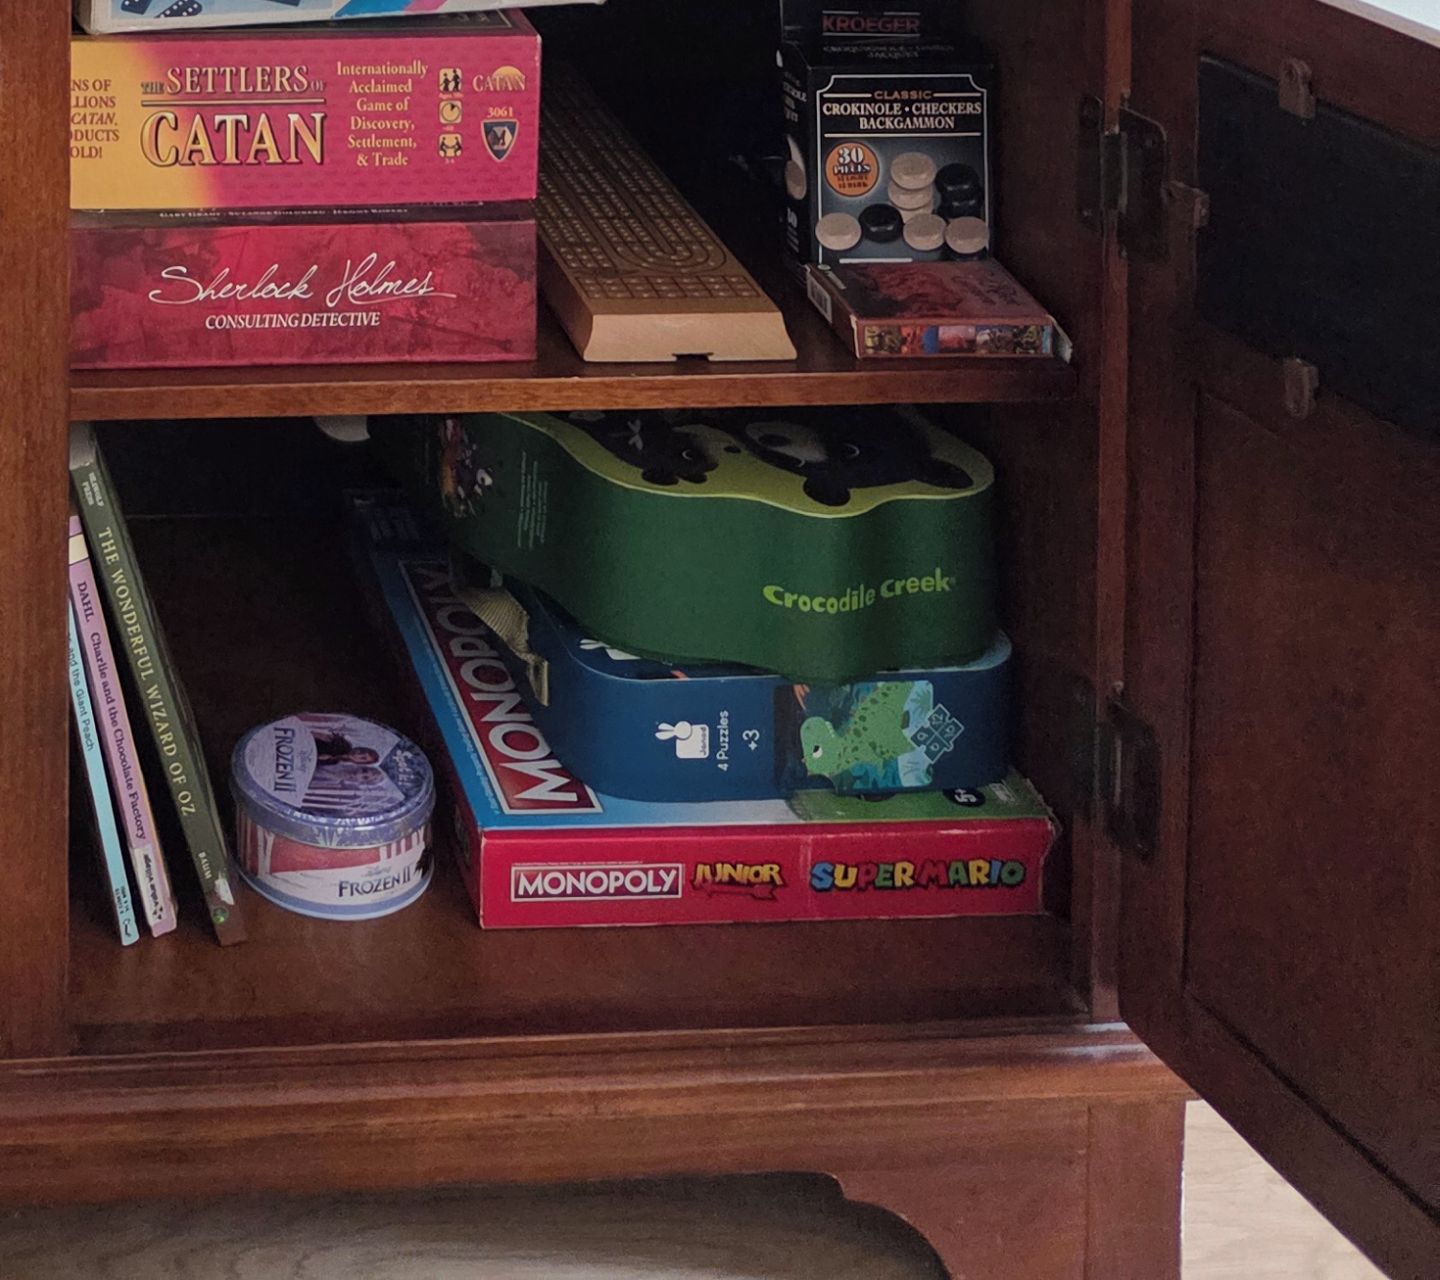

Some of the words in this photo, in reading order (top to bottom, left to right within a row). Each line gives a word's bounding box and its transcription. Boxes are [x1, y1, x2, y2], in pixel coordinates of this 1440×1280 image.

[821, 16, 921, 33] KROEGER
[166, 64, 309, 95] SETTLERS
[310, 80, 326, 93] OF
[337, 59, 429, 79] Internationally
[349, 79, 412, 94] Acclaimed
[472, 73, 526, 93] CATAN
[356, 98, 393, 112] Game
[396, 96, 410, 111] of
[874, 90, 933, 100] CLASSIC
[486, 106, 514, 119] 3061
[822, 102, 902, 116] CROKINOLE
[911, 101, 982, 116] CHECKERS
[350, 116, 415, 133] Discovery,
[859, 116, 955, 130] BACKGAMMON
[140, 110, 327, 167] CATAN
[347, 135, 417, 149] Settlement,
[356, 154, 368, 167] &
[372, 152, 409, 167] Trade
[838, 146, 864, 164] 30
[149, 263, 319, 305] Sherlock
[325, 252, 457, 307] Holmes
[205, 312, 300, 330] CONSULTING
[300, 311, 381, 328] DETECTIVE
[77, 580, 95, 623] DAHL
[762, 583, 876, 614] Crocodile
[879, 566, 951, 598] Creek
[90, 631, 108, 680] Charlie
[71, 666, 81, 686] the
[97, 526, 120, 564] THE
[111, 567, 148, 682] WONDERFUL
[145, 683, 176, 759] WIZARD
[167, 759, 185, 788] OF
[177, 791, 196, 817] OZ
[75, 688, 88, 718] Giant
[101, 680, 116, 705] and
[108, 705, 120, 728] the
[81, 717, 95, 752] Peach
[715, 709, 729, 760] Puzzles
[113, 728, 133, 791] Chocolate
[272, 726, 296, 779] FROZEN
[717, 762, 729, 772] 4
[273, 777, 297, 793] II
[128, 791, 146, 840] Factory
[198, 850, 213, 880] BAUM
[518, 868, 677, 896] MONOPOLY
[692, 861, 788, 890] JUNIOR
[810, 859, 916, 892] SUPER
[916, 857, 1027, 888] MARIO
[338, 872, 401, 898] FROZEN
[402, 865, 412, 884] II
